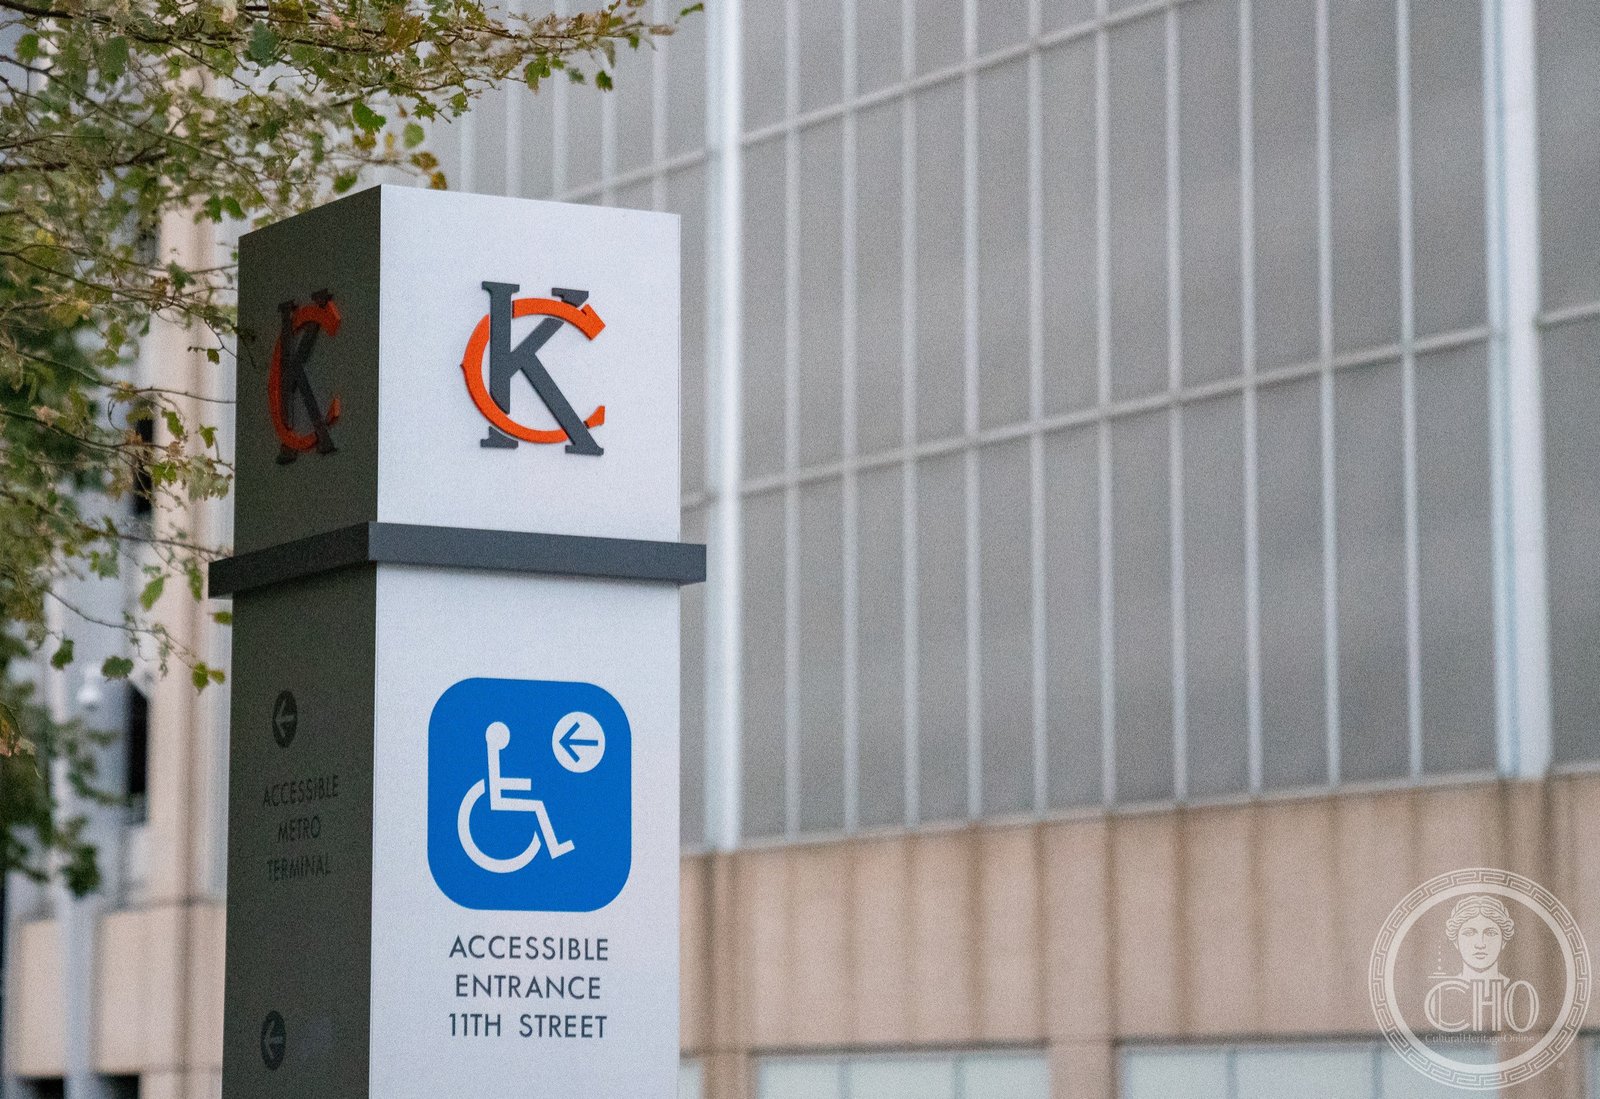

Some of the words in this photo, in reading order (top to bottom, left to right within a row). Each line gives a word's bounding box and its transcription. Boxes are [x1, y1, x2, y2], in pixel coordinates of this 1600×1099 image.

[460, 281, 606, 456] KC
[263, 775, 339, 807] ACCESSIBLE
[277, 815, 322, 843] METRO
[266, 854, 331, 882] TERMINAL
[449, 935, 609, 961] ACCESSIBLE
[455, 974, 601, 1000] ENTRANCE
[448, 1013, 501, 1037] 11TH
[519, 1013, 608, 1039] STREET
